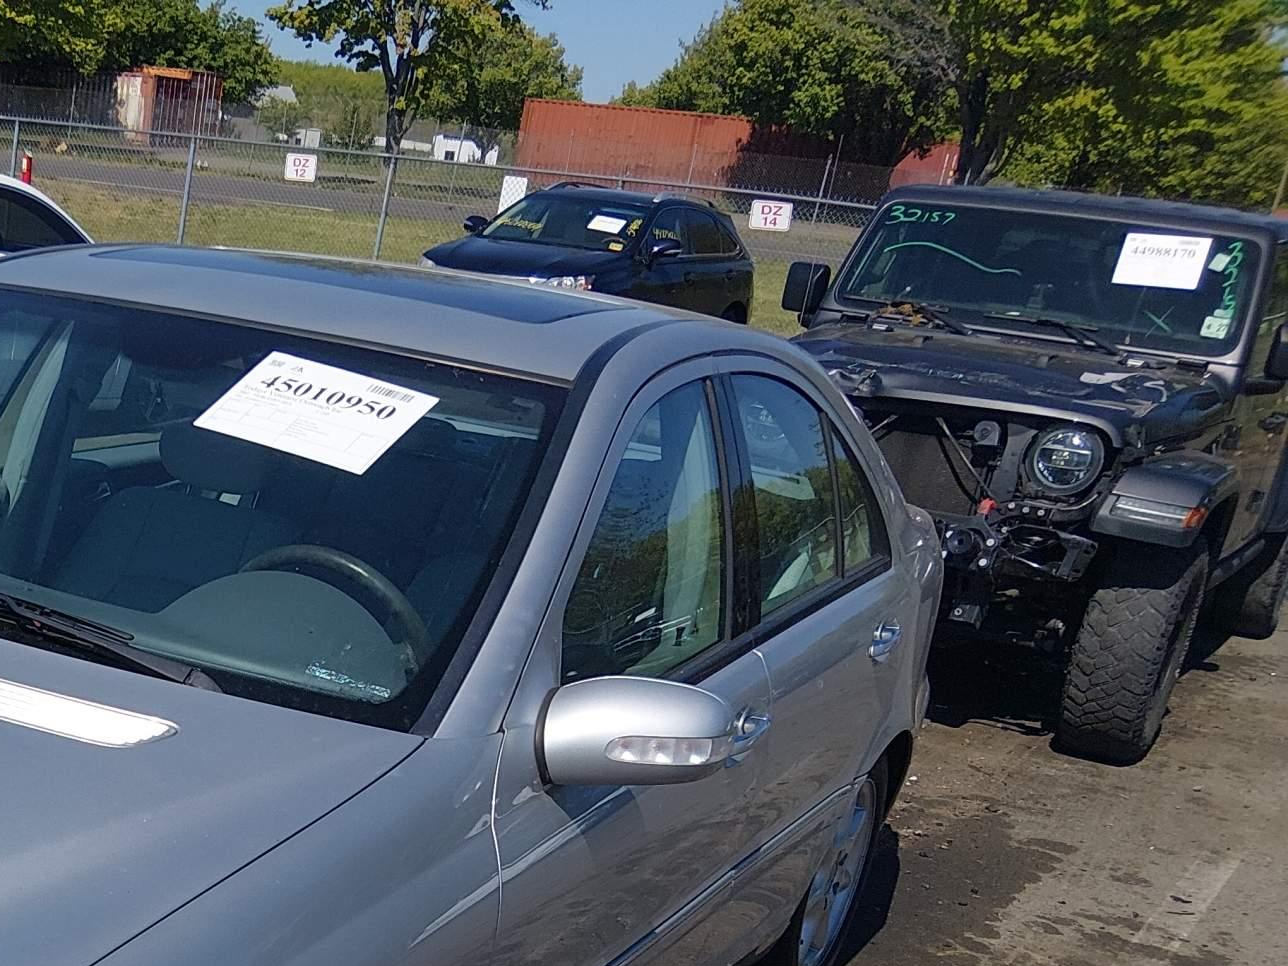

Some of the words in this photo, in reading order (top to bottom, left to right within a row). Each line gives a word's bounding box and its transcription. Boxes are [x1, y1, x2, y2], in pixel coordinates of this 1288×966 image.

[293, 158, 310, 168] DZ
[294, 168, 306, 178] 12
[761, 205, 784, 216] DZ
[885, 205, 956, 225] 32157
[763, 216, 777, 227] 14
[1131, 246, 1196, 258] 44988170
[261, 375, 397, 420] 45010950
